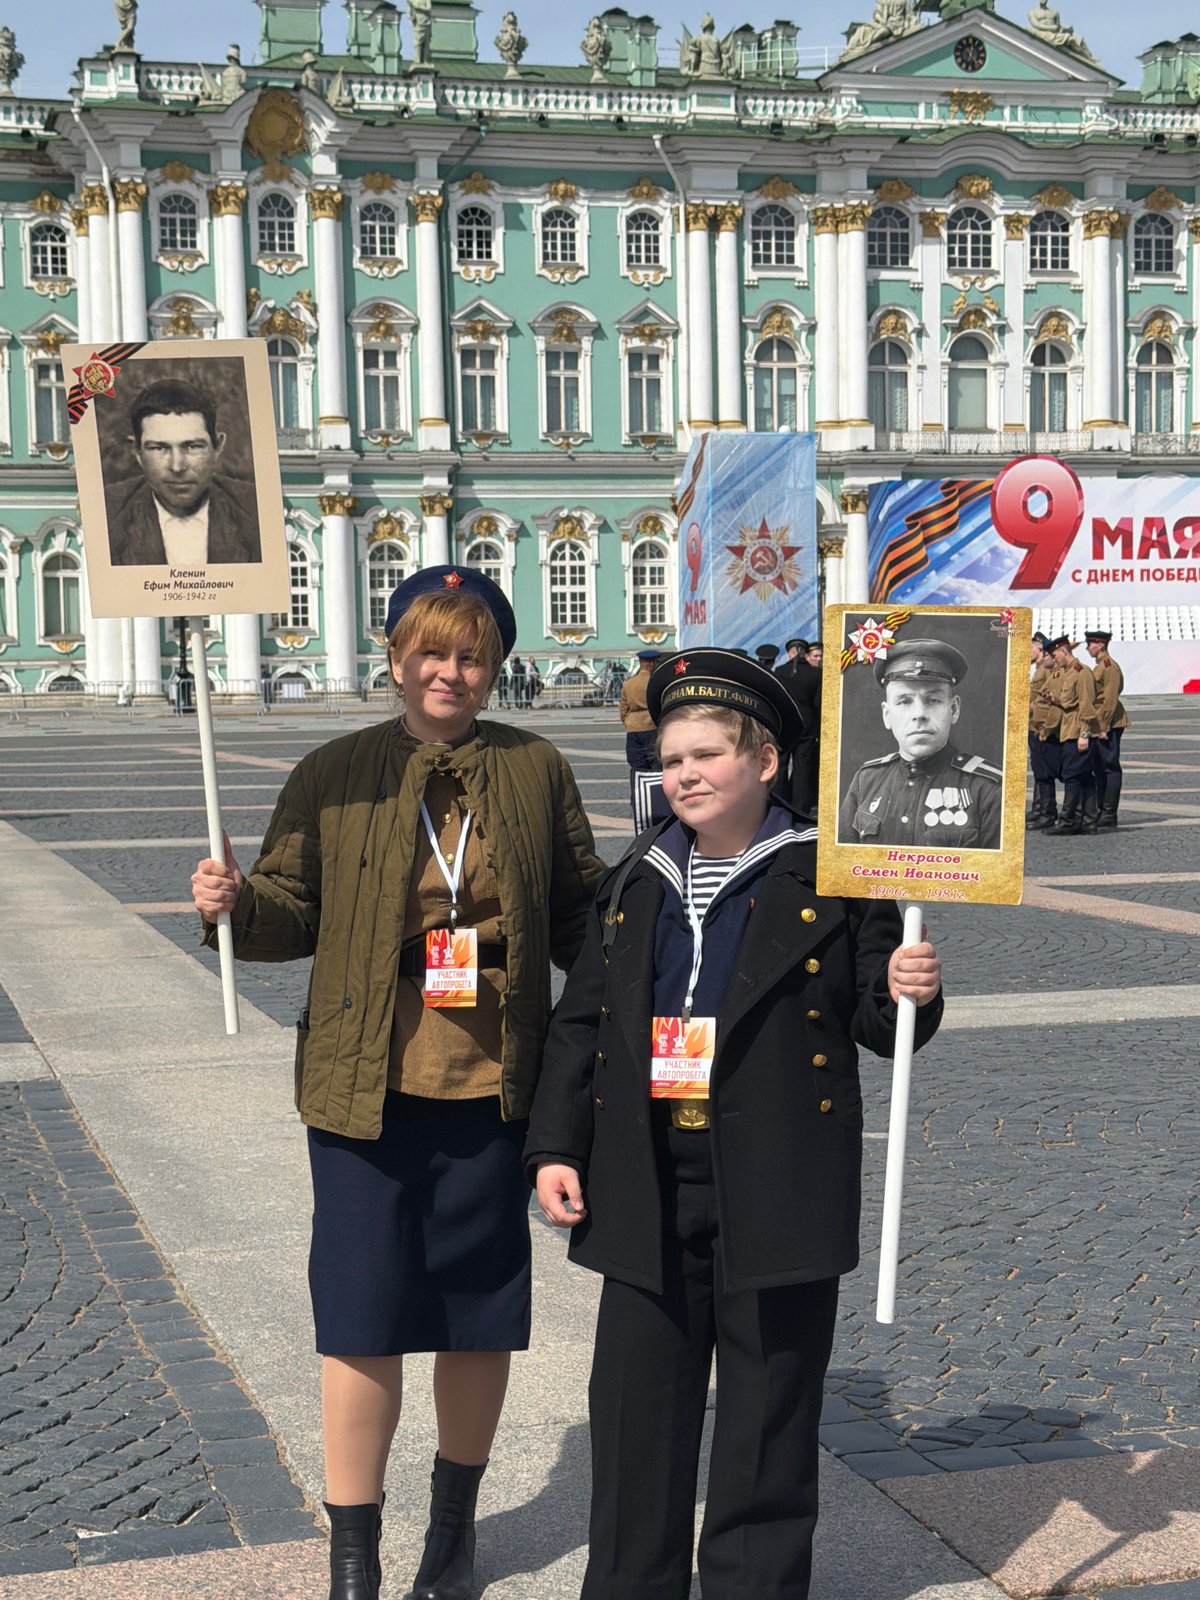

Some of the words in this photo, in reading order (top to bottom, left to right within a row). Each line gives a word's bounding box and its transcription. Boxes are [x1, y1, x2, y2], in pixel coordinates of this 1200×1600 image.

[991, 454, 1084, 590] 9
[1092, 517, 1200, 560] МАЯ
[686, 522, 702, 592] 9
[169, 569, 206, 578] Кленин
[1071, 570, 1082, 582] С
[1087, 569, 1134, 584] ДНЕМ
[1140, 567, 1200, 583] ПОБЕД
[143, 580, 171, 592] Ефим
[174, 579, 234, 589] Михайлович
[163, 592, 206, 601] 1906-1942
[685, 600, 706, 625] МАЯ
[887, 851, 961, 864] Некрасов
[852, 866, 899, 878] Семен
[904, 867, 980, 881] Иванович
[869, 885, 911, 898] 1906г.
[926, 888, 967, 900] 1981г.
[437, 971, 468, 979] УЧАСТНИК
[432, 981, 472, 989] АВТОПРОБЕГА
[664, 1060, 702, 1069] УЧАСТНИК
[657, 1070, 707, 1080] АВТОПРОБЕГА
